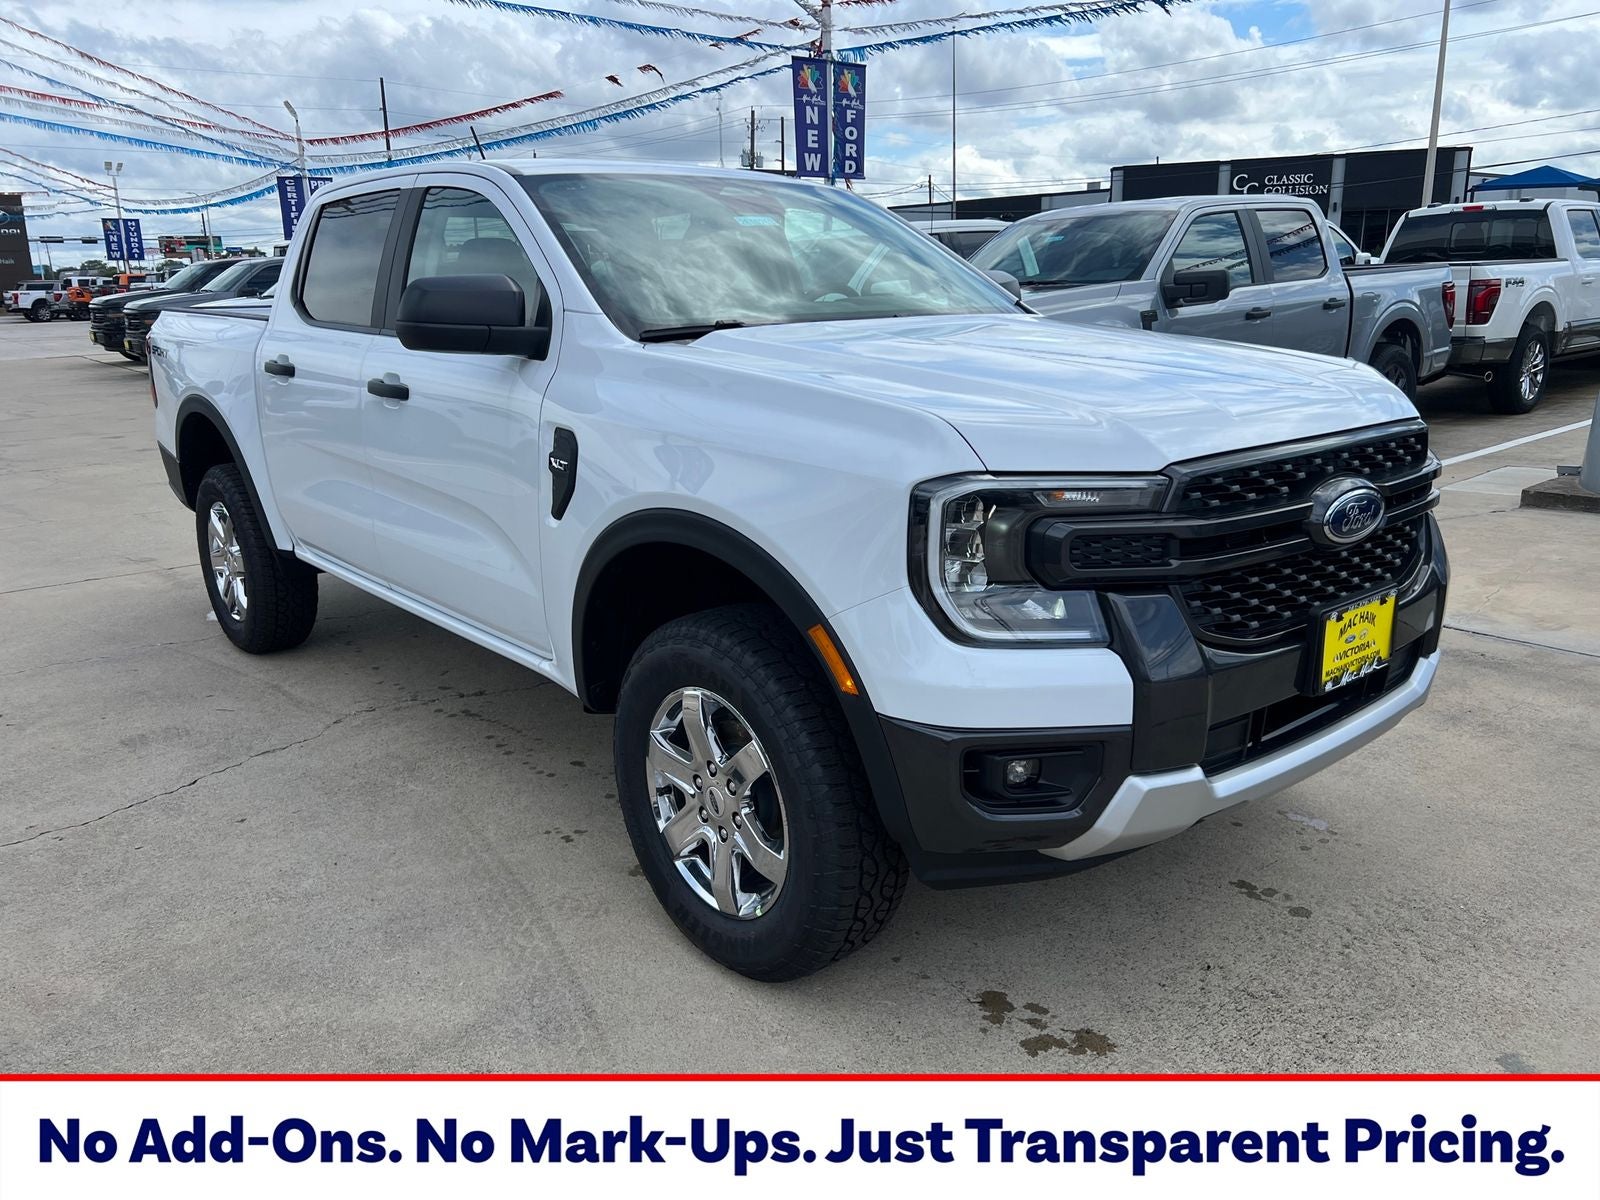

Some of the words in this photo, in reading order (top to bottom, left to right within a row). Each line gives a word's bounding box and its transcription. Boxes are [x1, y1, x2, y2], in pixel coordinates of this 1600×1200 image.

[804, 105, 821, 171] NEW
[844, 109, 858, 174] FORD
[1264, 173, 1314, 185] CLASSIC
[1264, 184, 1329, 195] COLLISION
[284, 179, 299, 236] CERTIFIE
[109, 234, 121, 258] NEW
[127, 221, 140, 258] HYUNDAI
[1341, 500, 1375, 532] Ford
[1338, 614, 1359, 640] MAC
[1359, 610, 1377, 627] HAIK
